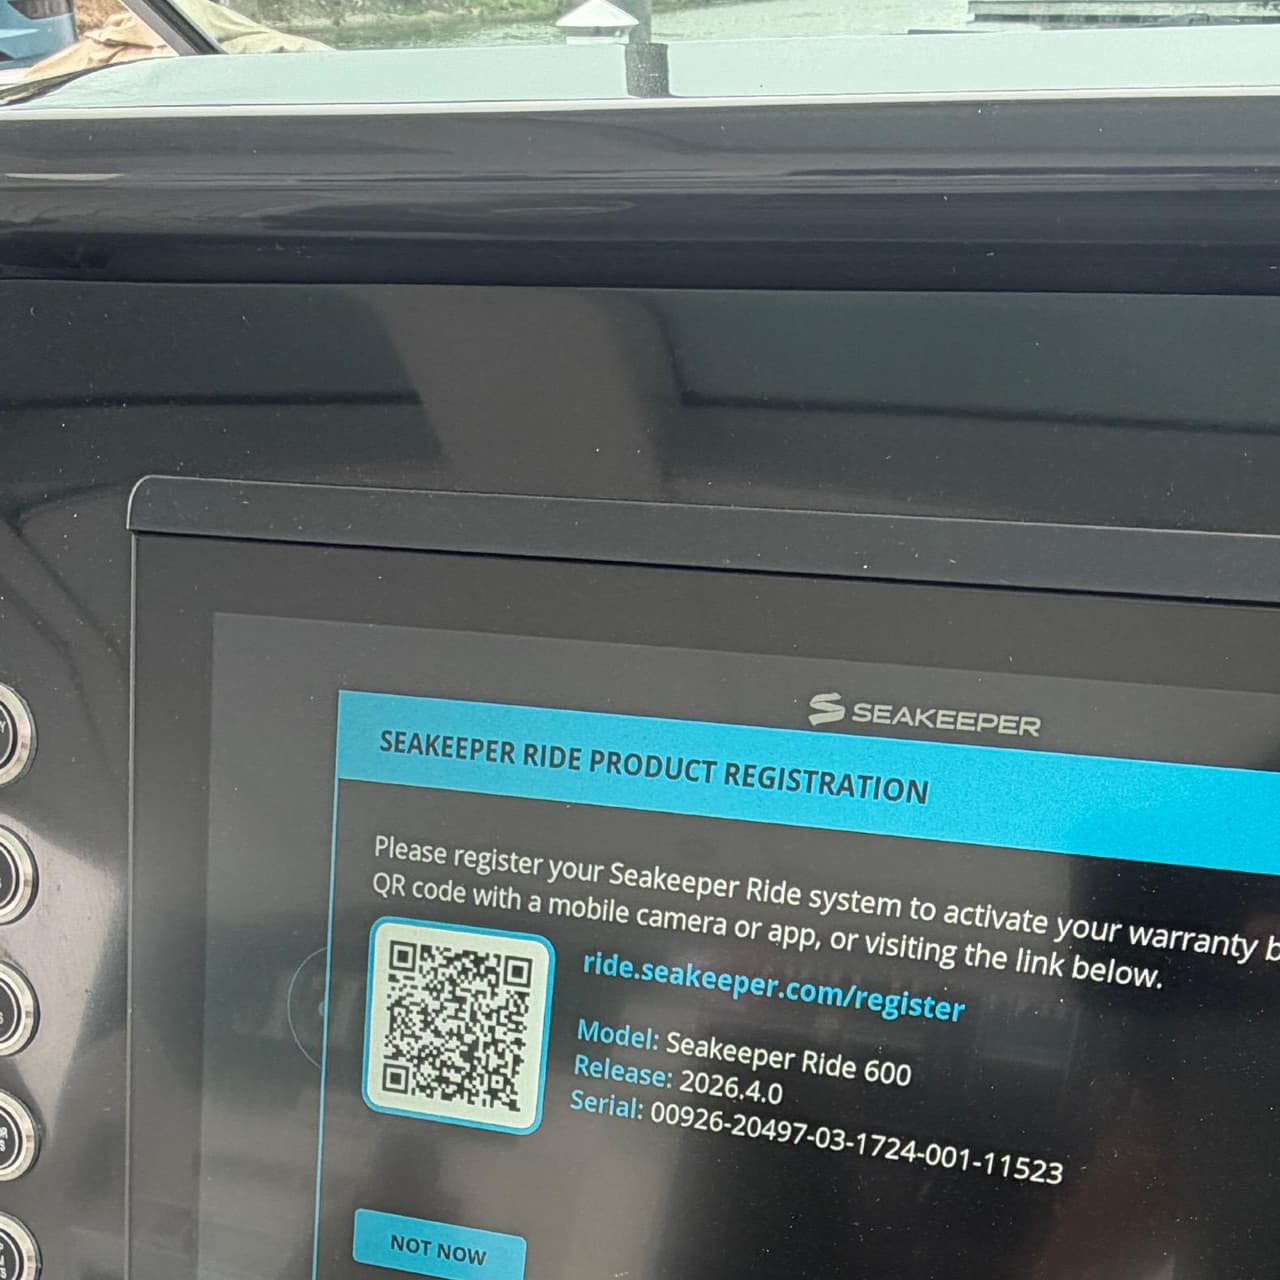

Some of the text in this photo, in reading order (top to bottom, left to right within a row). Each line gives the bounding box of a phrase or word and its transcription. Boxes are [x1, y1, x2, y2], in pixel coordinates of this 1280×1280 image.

[851, 700, 1042, 737] SEAKEEPER
[378, 729, 930, 805] SEAKEEPER RIDE PRODUCT REGISTRATION
[372, 871, 1164, 990] QR code with a mobile camera or app, or visiting the link below.
[374, 834, 447, 865] Please
[454, 845, 544, 876] register
[548, 858, 605, 884] your
[608, 861, 741, 901] Seakeeper
[745, 876, 802, 907] Ride
[808, 886, 903, 919] system
[909, 897, 937, 922] to
[943, 902, 1049, 935] activate
[1052, 915, 1124, 946] your
[1128, 924, 1259, 966] warranty
[583, 951, 967, 1023] ride.seakeeper.com/register
[574, 1053, 785, 1105] Release: 2026.4.0
[576, 1018, 912, 1088] Model: Seakeeper Ride 600
[569, 1088, 1064, 1186] Serial: 00926-20497-03-1724-001-11523
[390, 1233, 488, 1268] NOT NOW
